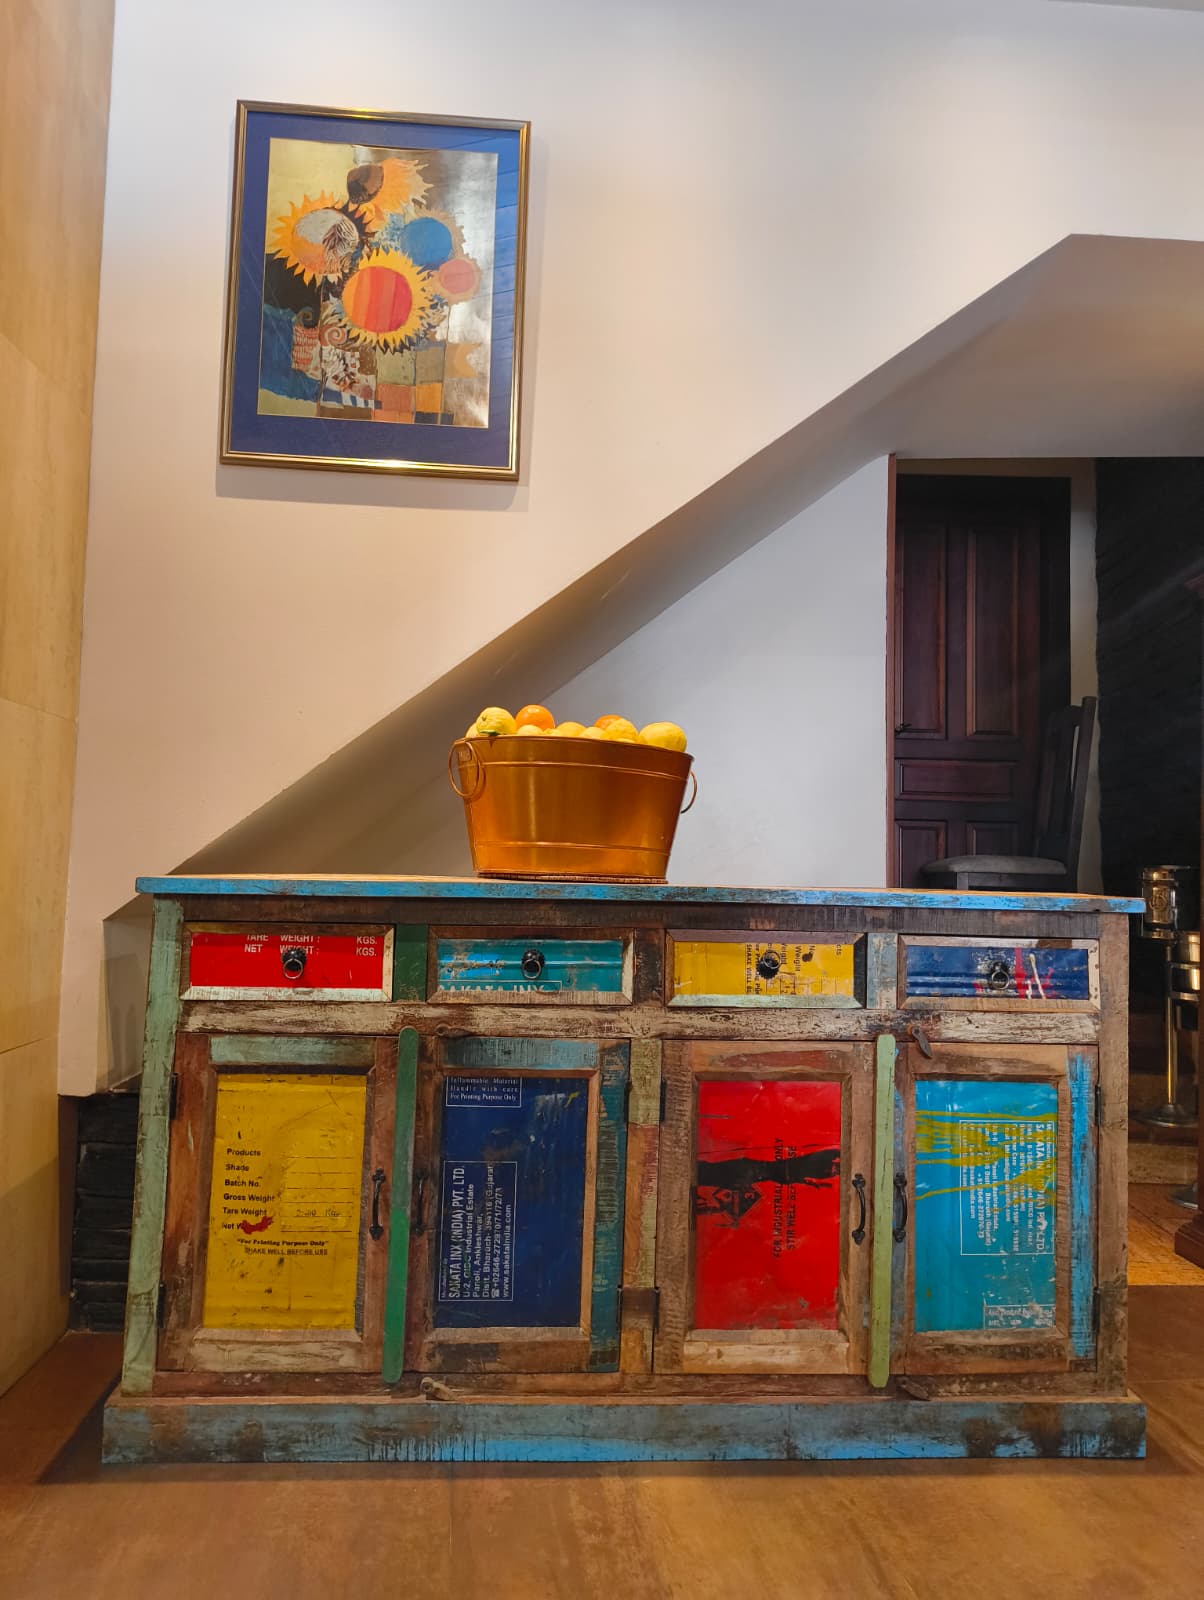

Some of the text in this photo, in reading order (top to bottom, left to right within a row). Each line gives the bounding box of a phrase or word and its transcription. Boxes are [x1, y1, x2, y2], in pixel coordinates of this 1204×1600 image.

[245, 944, 262, 952] NET
[356, 948, 377, 956] KGS.
[227, 1148, 261, 1156] Products
[225, 1179, 246, 1187] Batch
[249, 1194, 275, 1203] Weight
[452, 1188, 465, 1207] PVT.
[466, 1184, 474, 1210] Estate
[241, 1208, 267, 1216] Weight
[773, 1184, 783, 1237] INDUSTRIAL
[787, 1204, 796, 1226] WELL
[451, 1210, 465, 1242] (INDIA)
[465, 1213, 473, 1253] Industrial
[773, 1239, 783, 1257] FOR
[786, 1230, 796, 1250] STIR
[451, 1245, 462, 1260] INX
[449, 1263, 461, 1298] SAKATA
